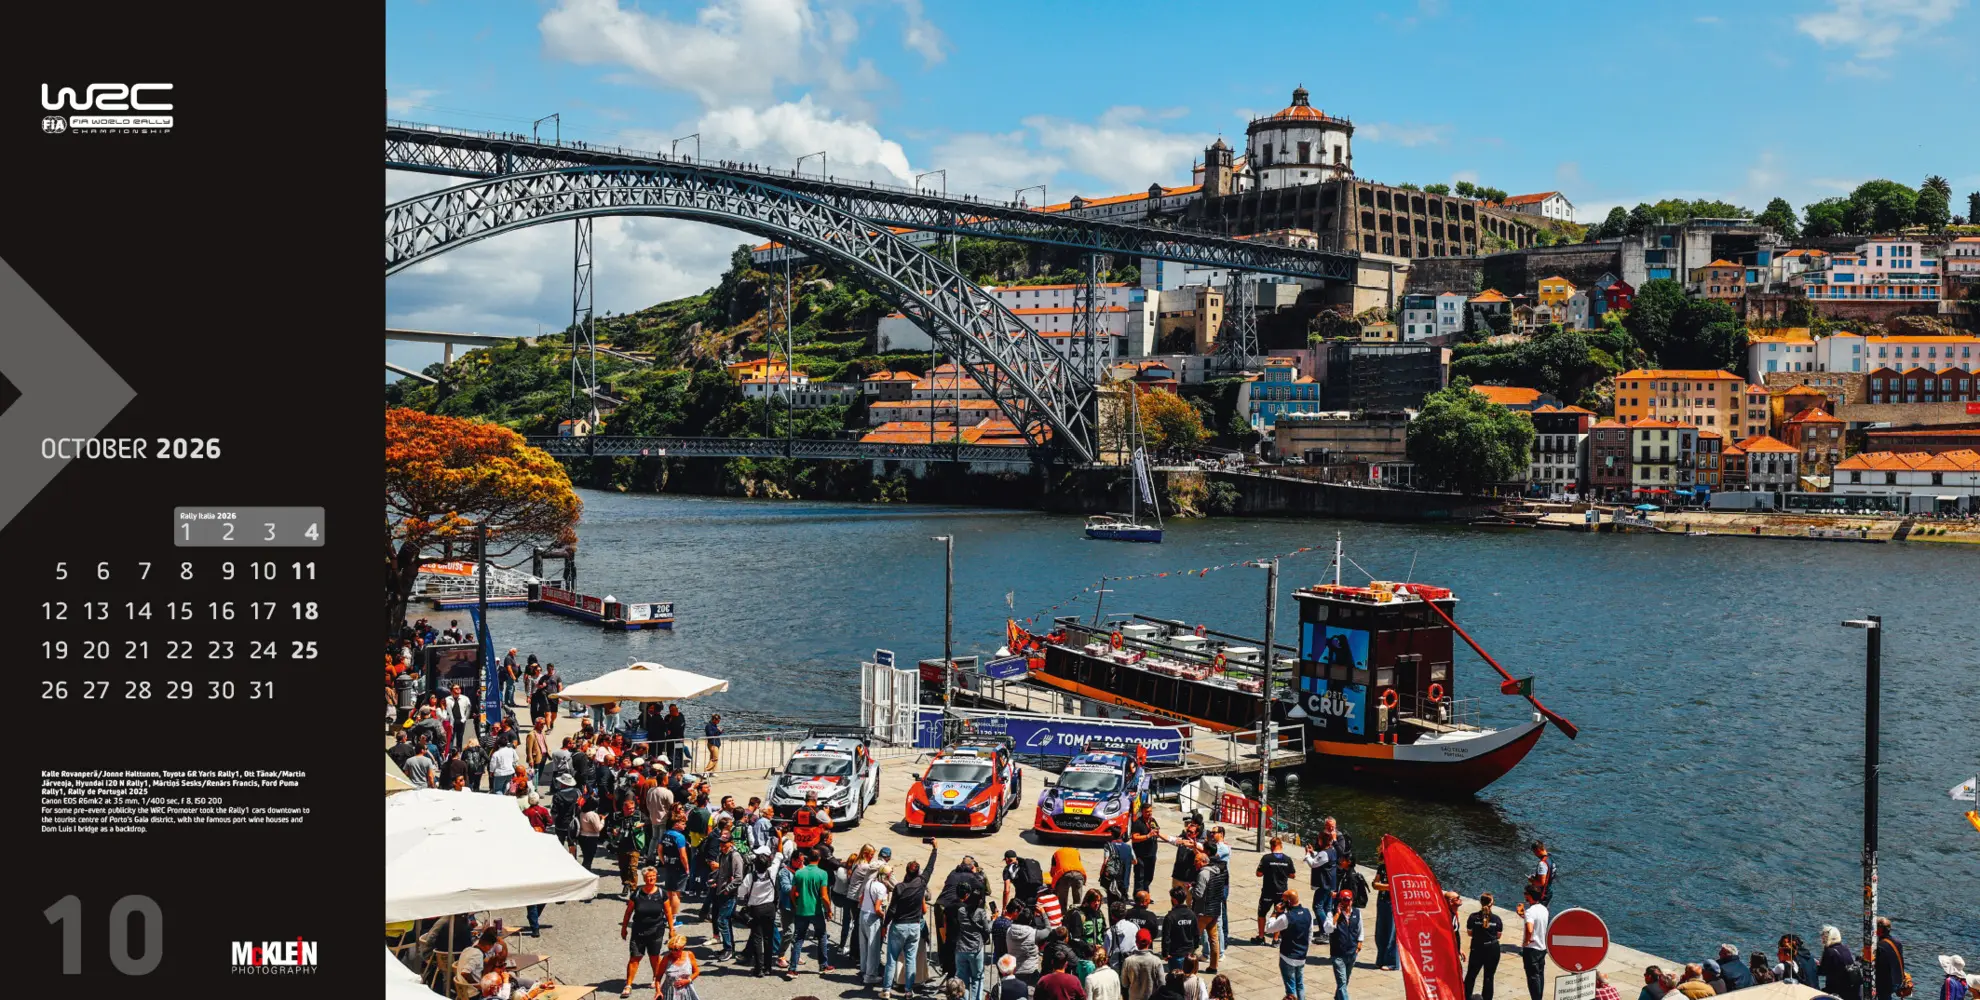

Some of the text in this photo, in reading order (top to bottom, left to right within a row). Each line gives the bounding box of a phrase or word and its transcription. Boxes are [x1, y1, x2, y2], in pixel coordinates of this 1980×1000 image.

[1752, 453, 1792, 461] SPORT
[1308, 695, 1356, 719] CRUZ
[1057, 733, 1102, 746] TOMAZ
